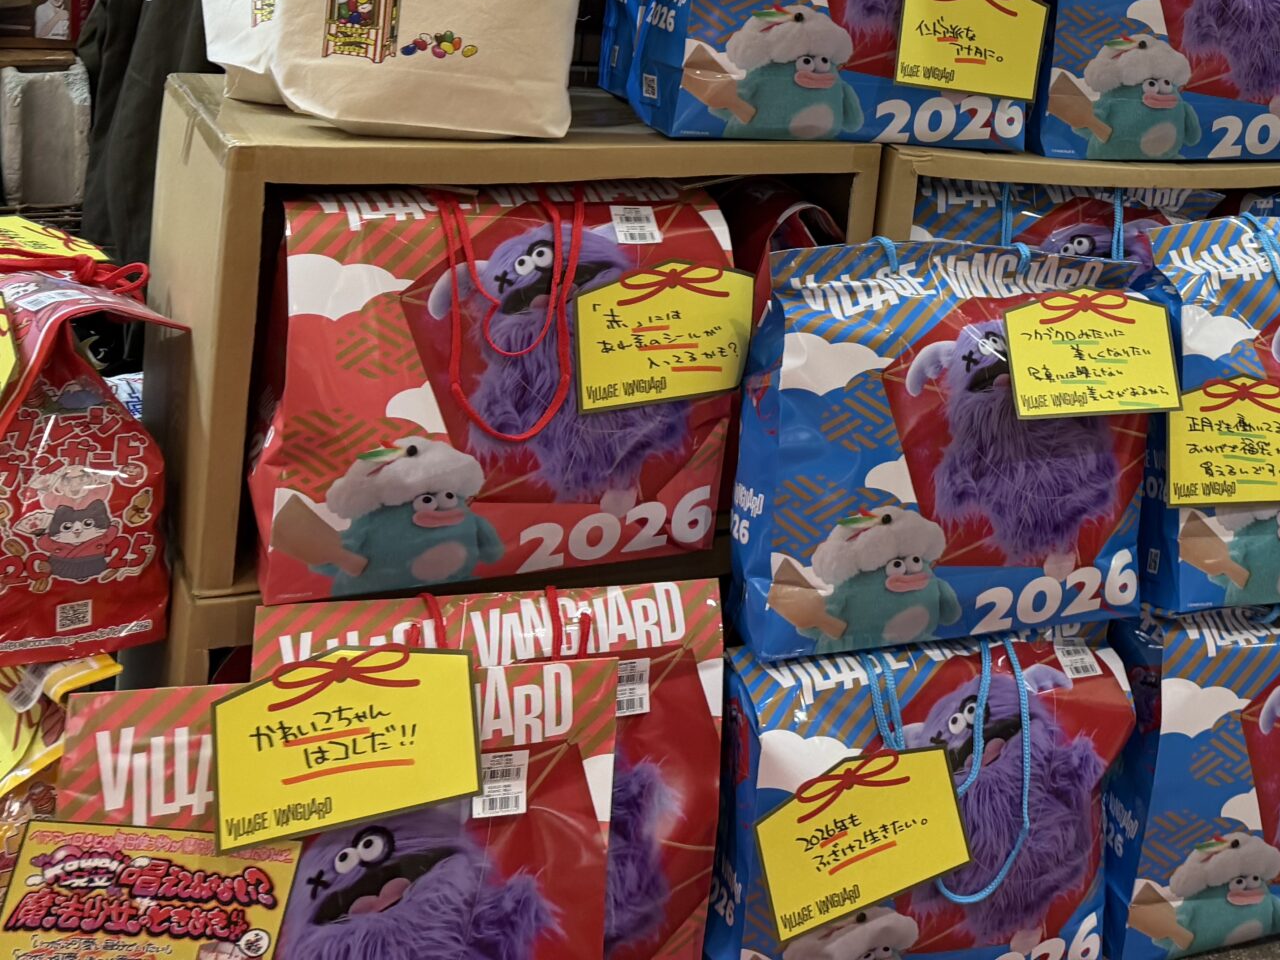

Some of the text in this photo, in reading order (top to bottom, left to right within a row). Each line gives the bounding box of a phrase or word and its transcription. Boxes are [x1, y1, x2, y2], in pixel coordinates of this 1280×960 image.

[871, 96, 1023, 144] 2026
[790, 251, 1103, 320] VILLAGE VANGUARD
[585, 376, 668, 404] VILLAGE VANGUARD
[1021, 392, 1088, 410] VILLAGE VANGUARD
[1173, 480, 1237, 498] VILLAGE VANGUARD
[518, 486, 712, 573] 2026
[969, 548, 1138, 636] 2026
[470, 581, 687, 667] VANGUARD
[249, 705, 392, 752] かわいこちゃん
[302, 724, 419, 770] はコレだ!!
[96, 727, 214, 827] VILL
[224, 796, 334, 841] VILLAGE VANGUARD
[811, 816, 929, 872] ふざけて生きたい。
[779, 883, 862, 932] VILLAGE VANGUARD
